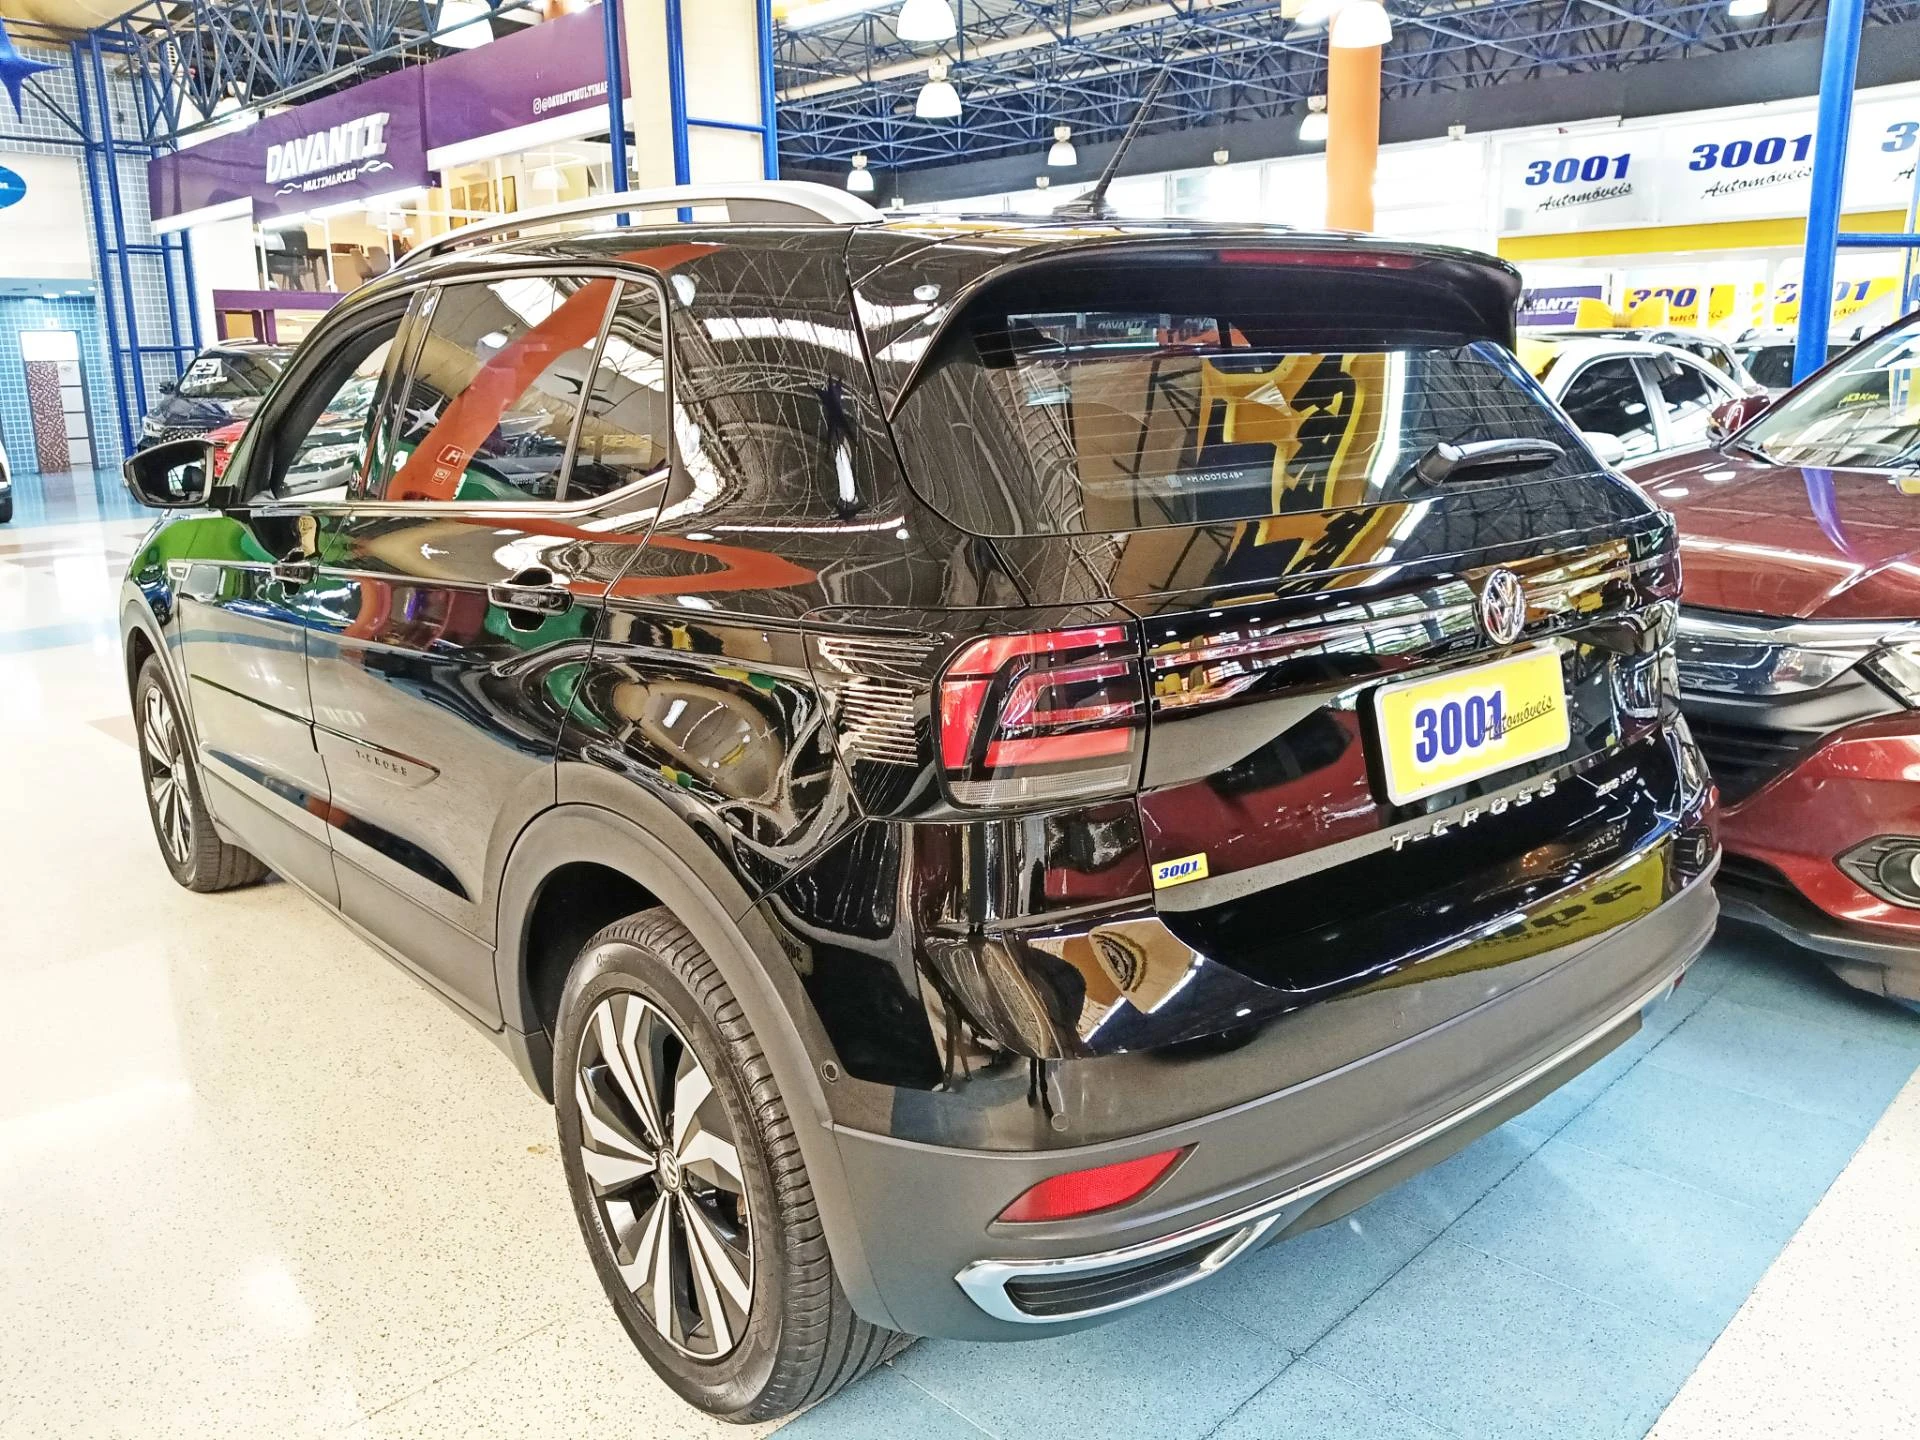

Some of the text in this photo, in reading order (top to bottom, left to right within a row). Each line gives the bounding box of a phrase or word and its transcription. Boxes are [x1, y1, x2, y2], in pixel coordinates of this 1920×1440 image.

[266, 112, 390, 183] DAVANTI
[1688, 134, 1813, 171] 3001
[303, 168, 358, 192] MULTIMARCAS
[1525, 153, 1631, 186] 3001
[1536, 182, 1633, 212] Automóveis
[1415, 690, 1553, 763] 3001 Automóveis
[1391, 778, 1557, 852] T-CROSS
[1158, 860, 1198, 880] 3001
